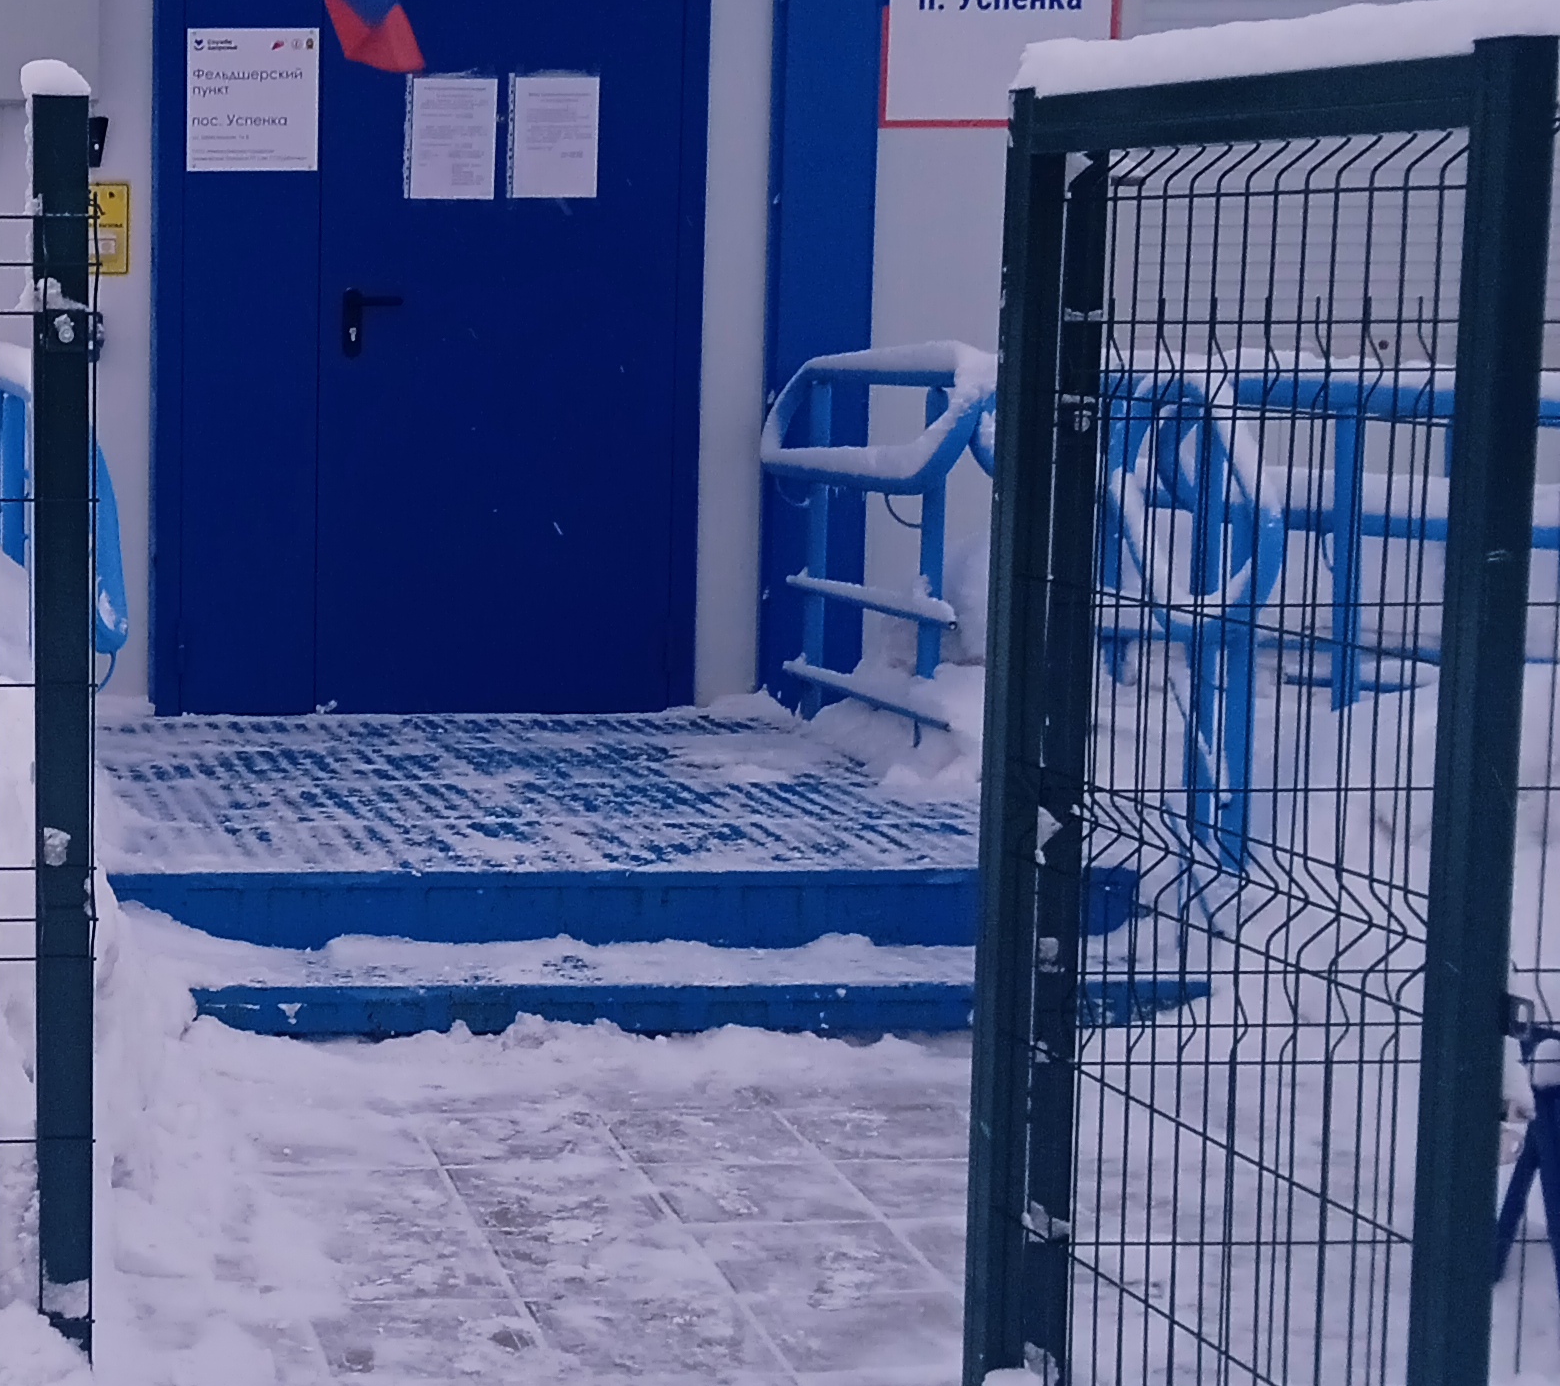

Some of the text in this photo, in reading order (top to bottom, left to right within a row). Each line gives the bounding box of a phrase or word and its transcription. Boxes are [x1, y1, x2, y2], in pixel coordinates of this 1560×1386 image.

[192, 68, 303, 82] Фельдшерский
[192, 85, 230, 98] пункт
[192, 114, 288, 127] пос. Успенка
